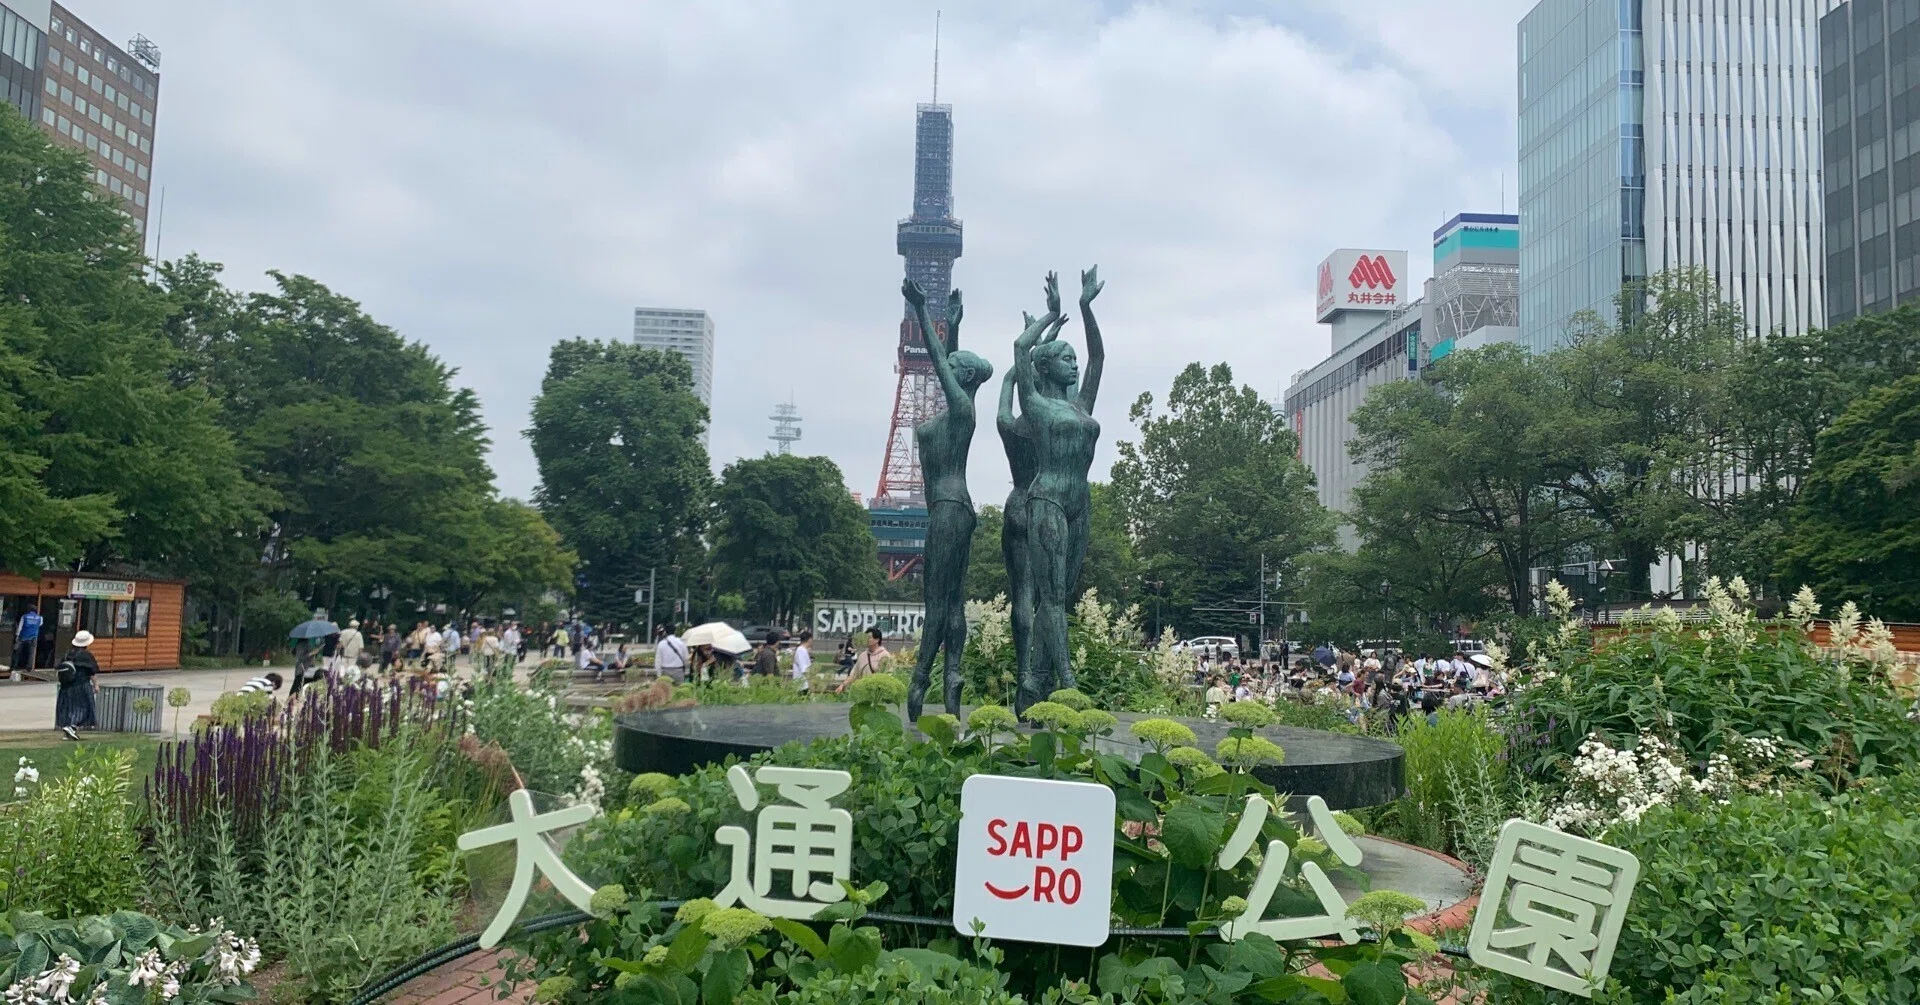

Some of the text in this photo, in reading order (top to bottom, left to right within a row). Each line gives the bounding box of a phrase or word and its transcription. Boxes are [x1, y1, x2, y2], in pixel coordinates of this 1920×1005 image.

[1348, 292, 1396, 304] 丸井今井
[987, 818, 1083, 861] SAPP
[1033, 866, 1082, 905] RO
